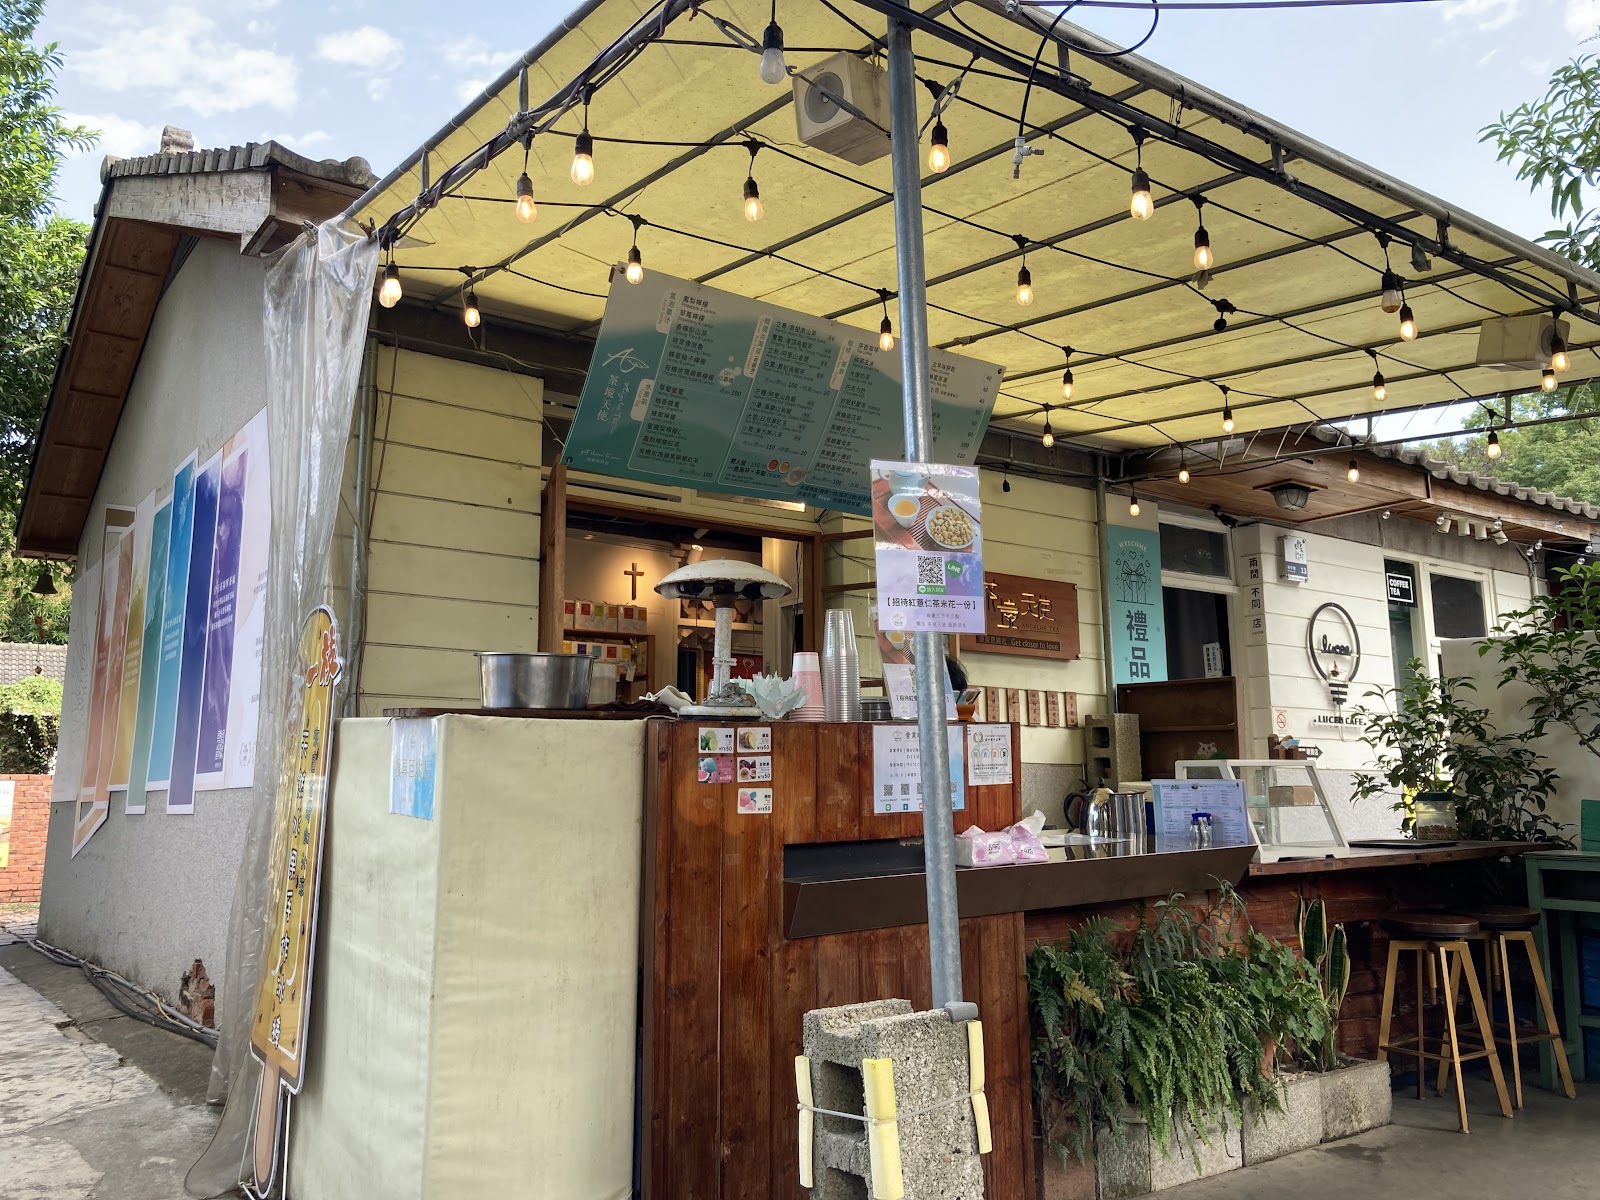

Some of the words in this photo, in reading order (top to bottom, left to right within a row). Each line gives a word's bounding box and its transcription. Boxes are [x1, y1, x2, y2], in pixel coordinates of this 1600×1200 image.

[596, 373, 620, 421] 茶境天使
[1119, 540, 1147, 552] WELCOME
[947, 563, 961, 574] LINE
[1300, 567, 1307, 575] 13
[1389, 579, 1410, 589] COFFEE
[1390, 587, 1401, 597] TEA
[1252, 618, 1262, 629] 店
[1022, 640, 1039, 649] closer
[1046, 643, 1059, 651] love
[1125, 609, 1150, 678] 禮品
